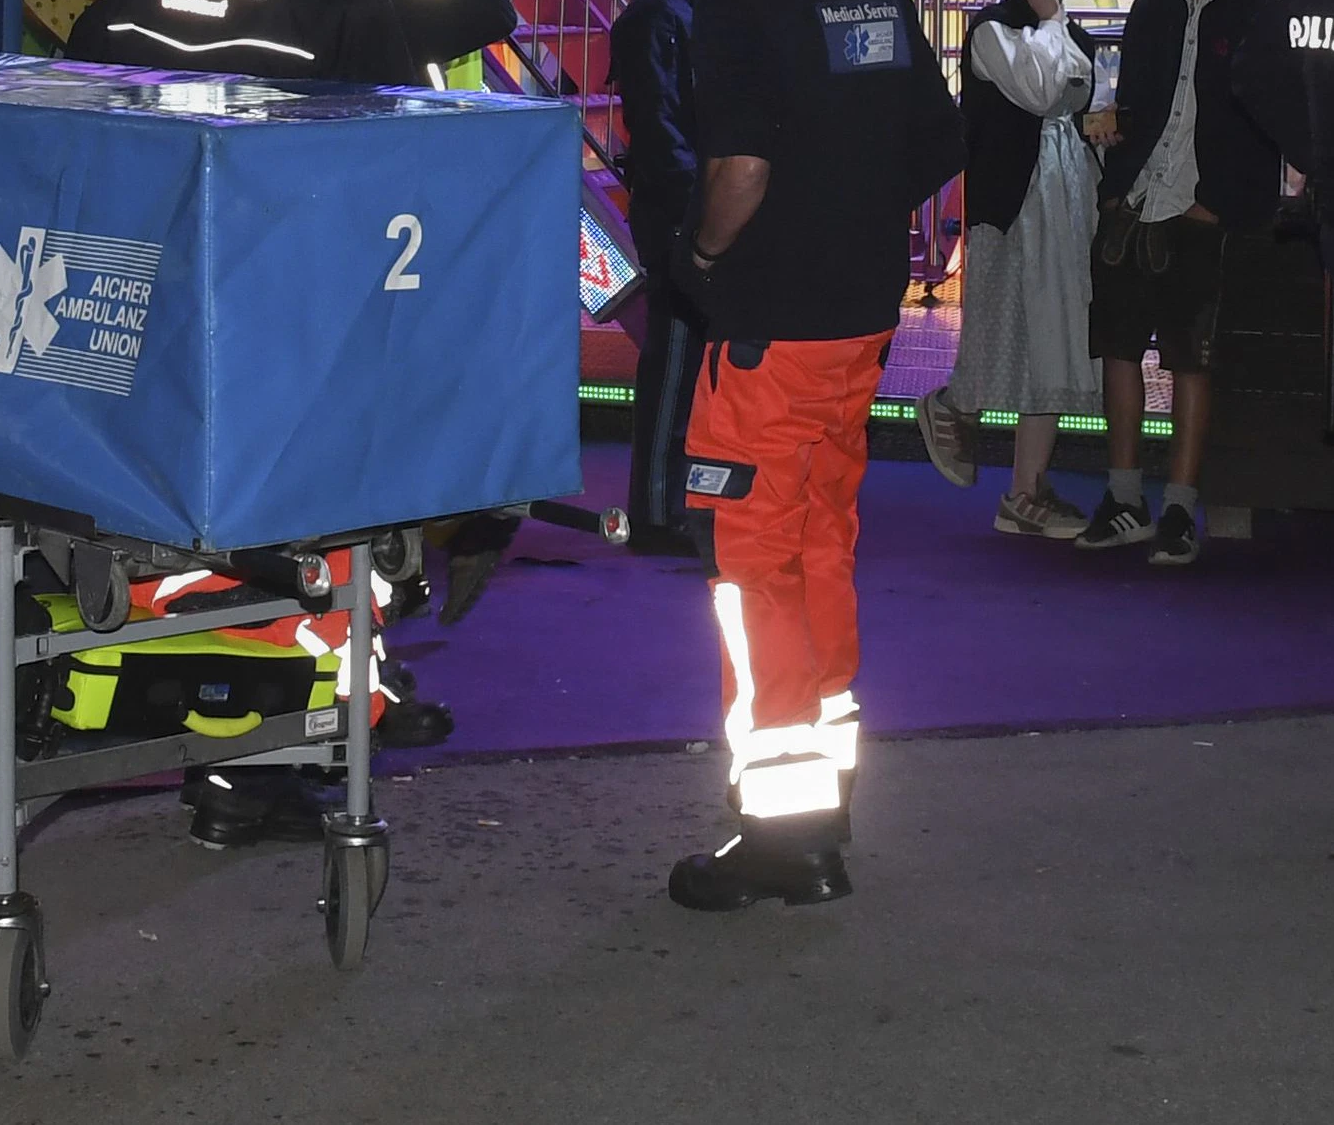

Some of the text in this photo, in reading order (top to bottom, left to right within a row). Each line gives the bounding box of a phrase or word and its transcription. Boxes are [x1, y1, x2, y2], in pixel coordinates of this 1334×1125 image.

[822, 2, 899, 24] Medical Service
[384, 213, 422, 291] 2
[89, 274, 152, 306] AICHER
[54, 296, 147, 331] AMBULANZ
[89, 328, 142, 359] UNION
